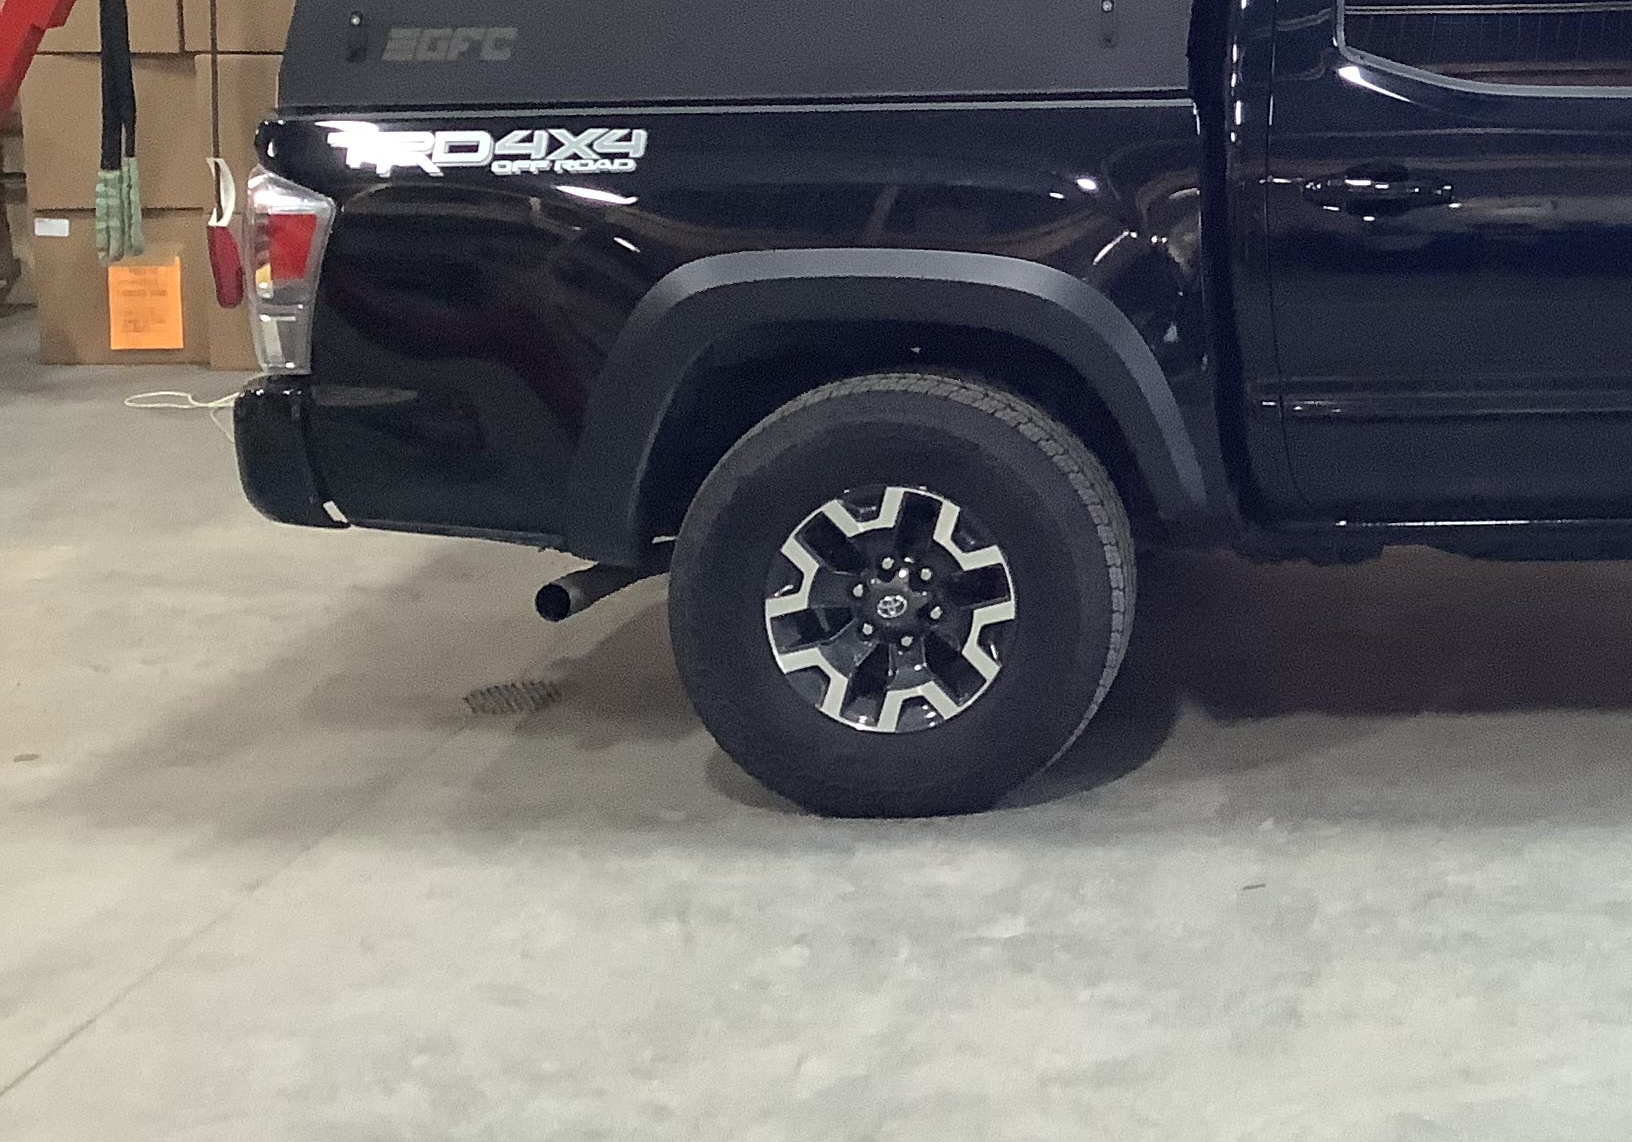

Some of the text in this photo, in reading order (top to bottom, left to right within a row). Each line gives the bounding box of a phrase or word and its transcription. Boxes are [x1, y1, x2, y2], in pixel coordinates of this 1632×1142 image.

[414, 26, 519, 60] GFC
[327, 130, 494, 177] TRD
[491, 158, 637, 175] OFF ROAD
